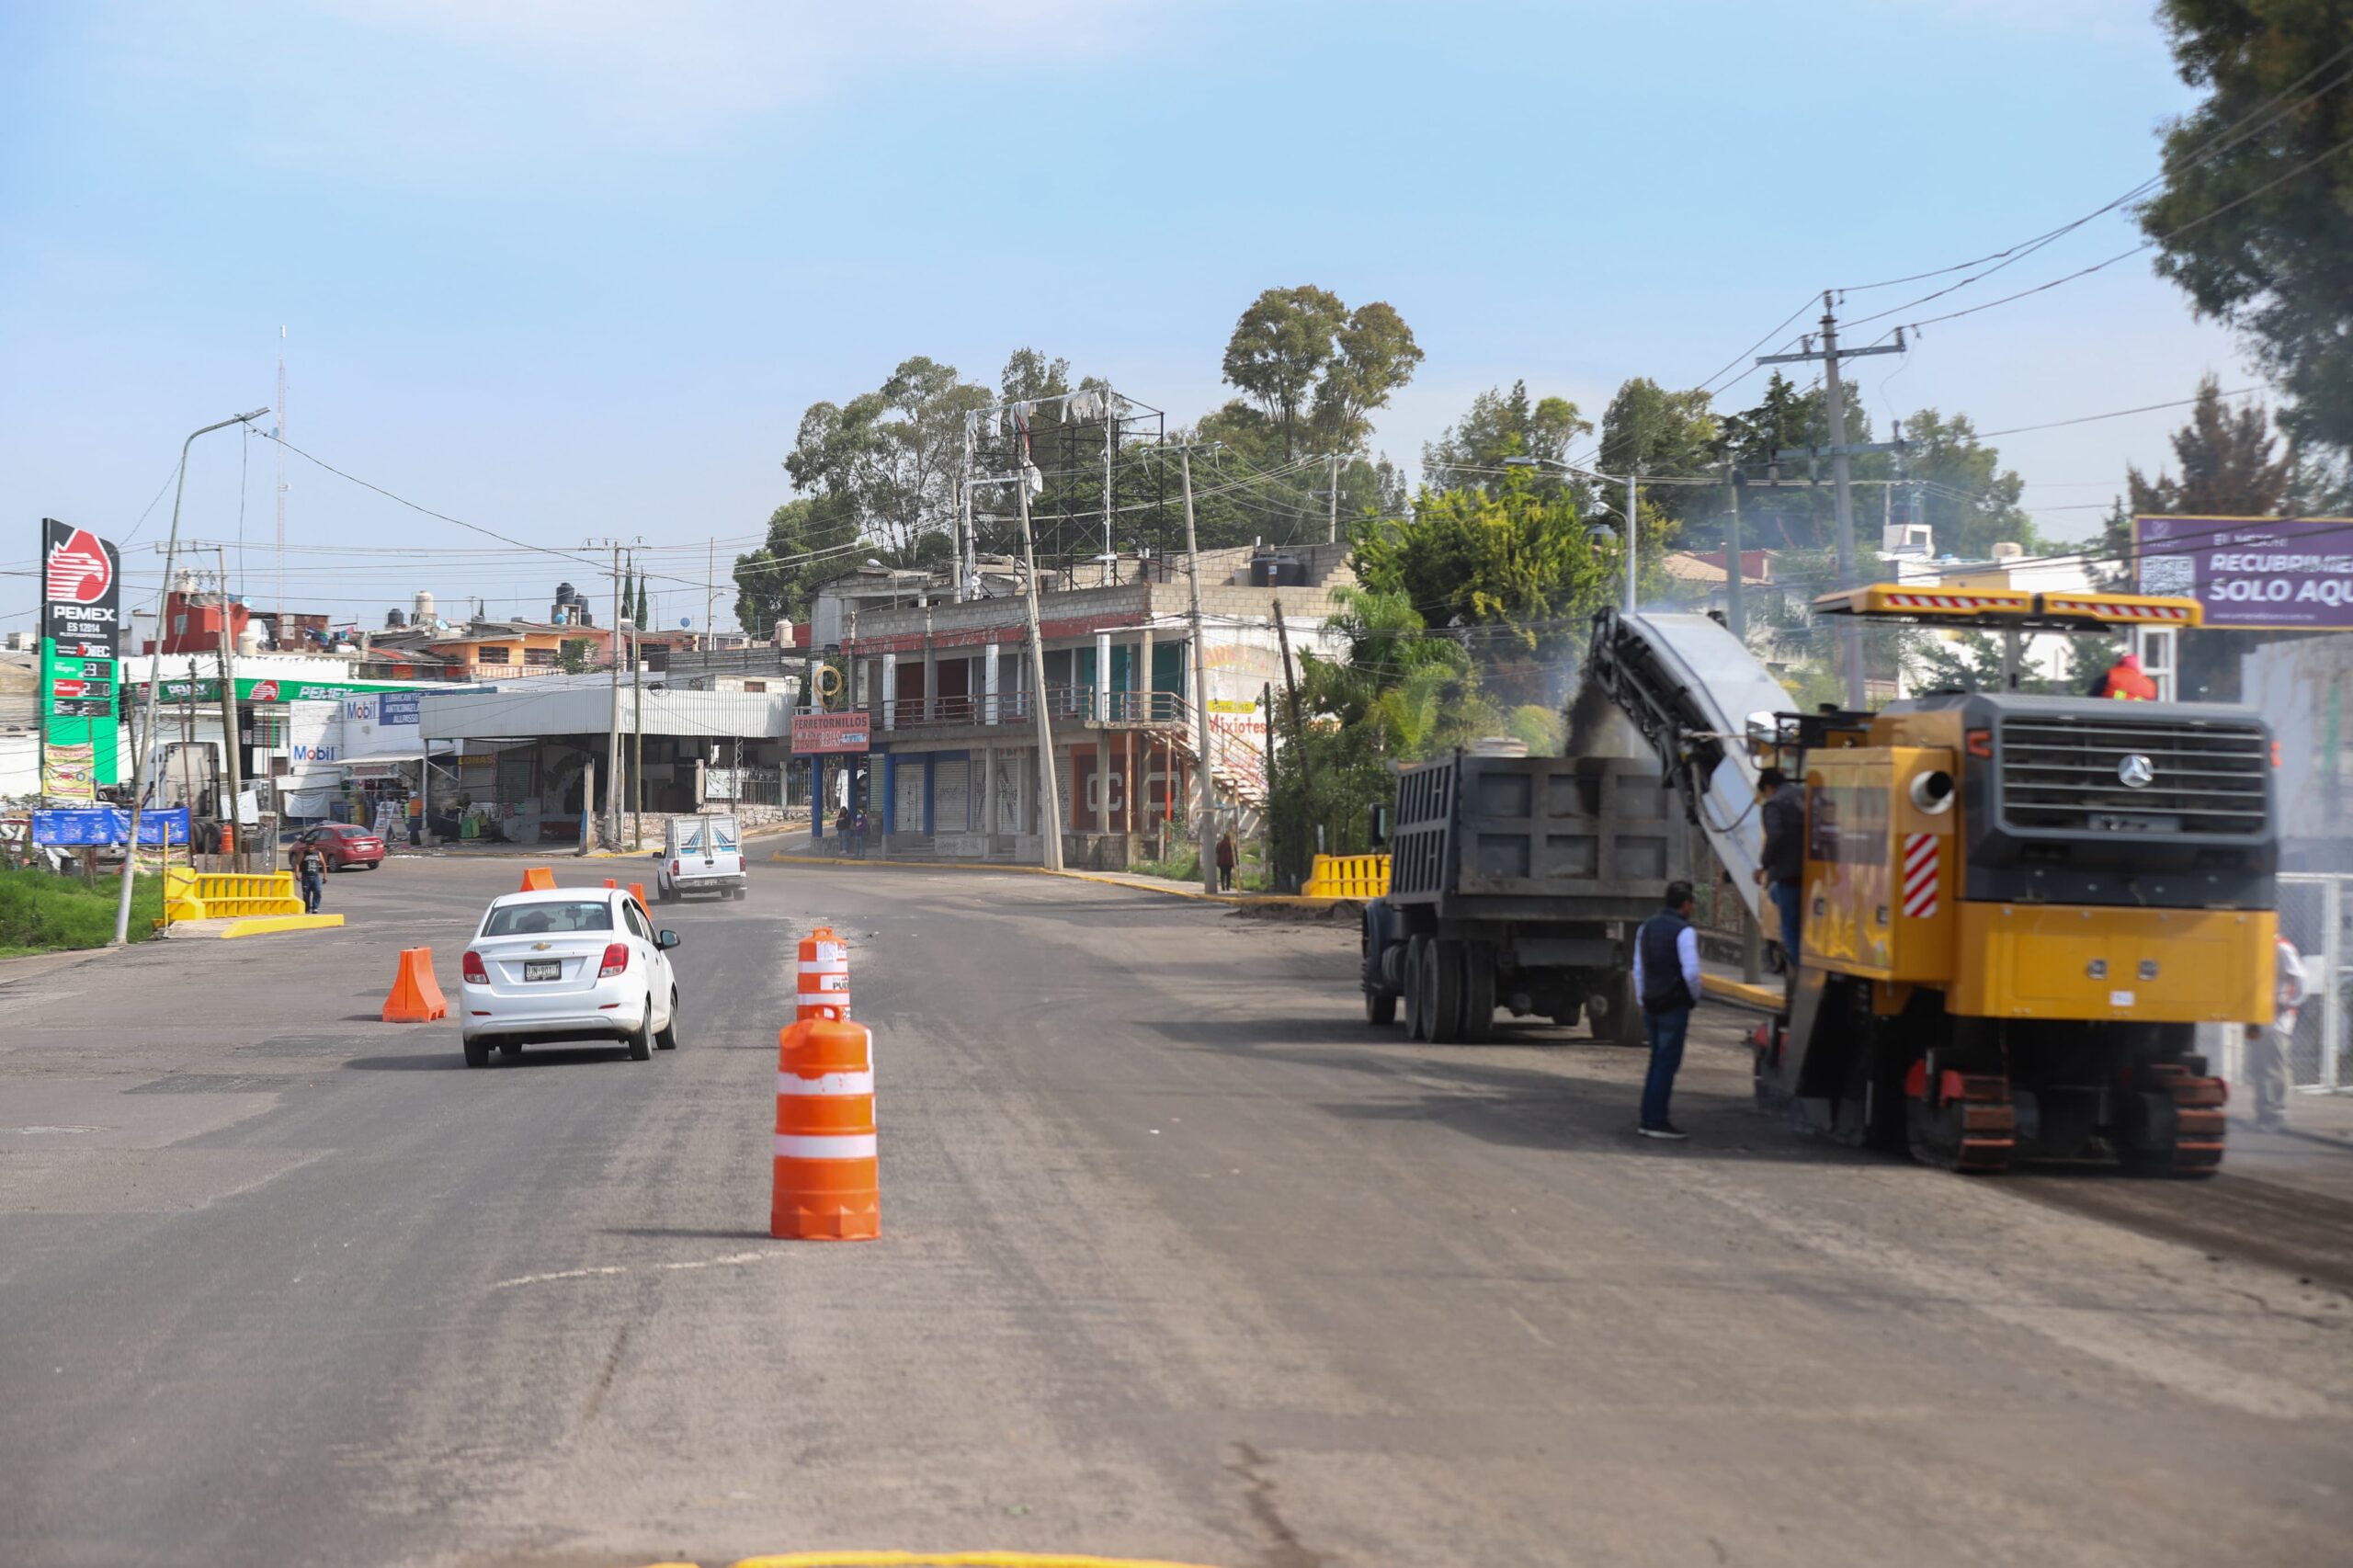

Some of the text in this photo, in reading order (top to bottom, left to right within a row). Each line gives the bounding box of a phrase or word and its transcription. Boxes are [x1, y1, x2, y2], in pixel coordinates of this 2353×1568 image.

[53, 606, 116, 621] PEMEX
[385, 692, 423, 702] LUBRICANTE
[347, 701, 376, 720] Mobil
[794, 717, 867, 730] FERRETORNILLOS
[294, 745, 335, 761] Mobil
